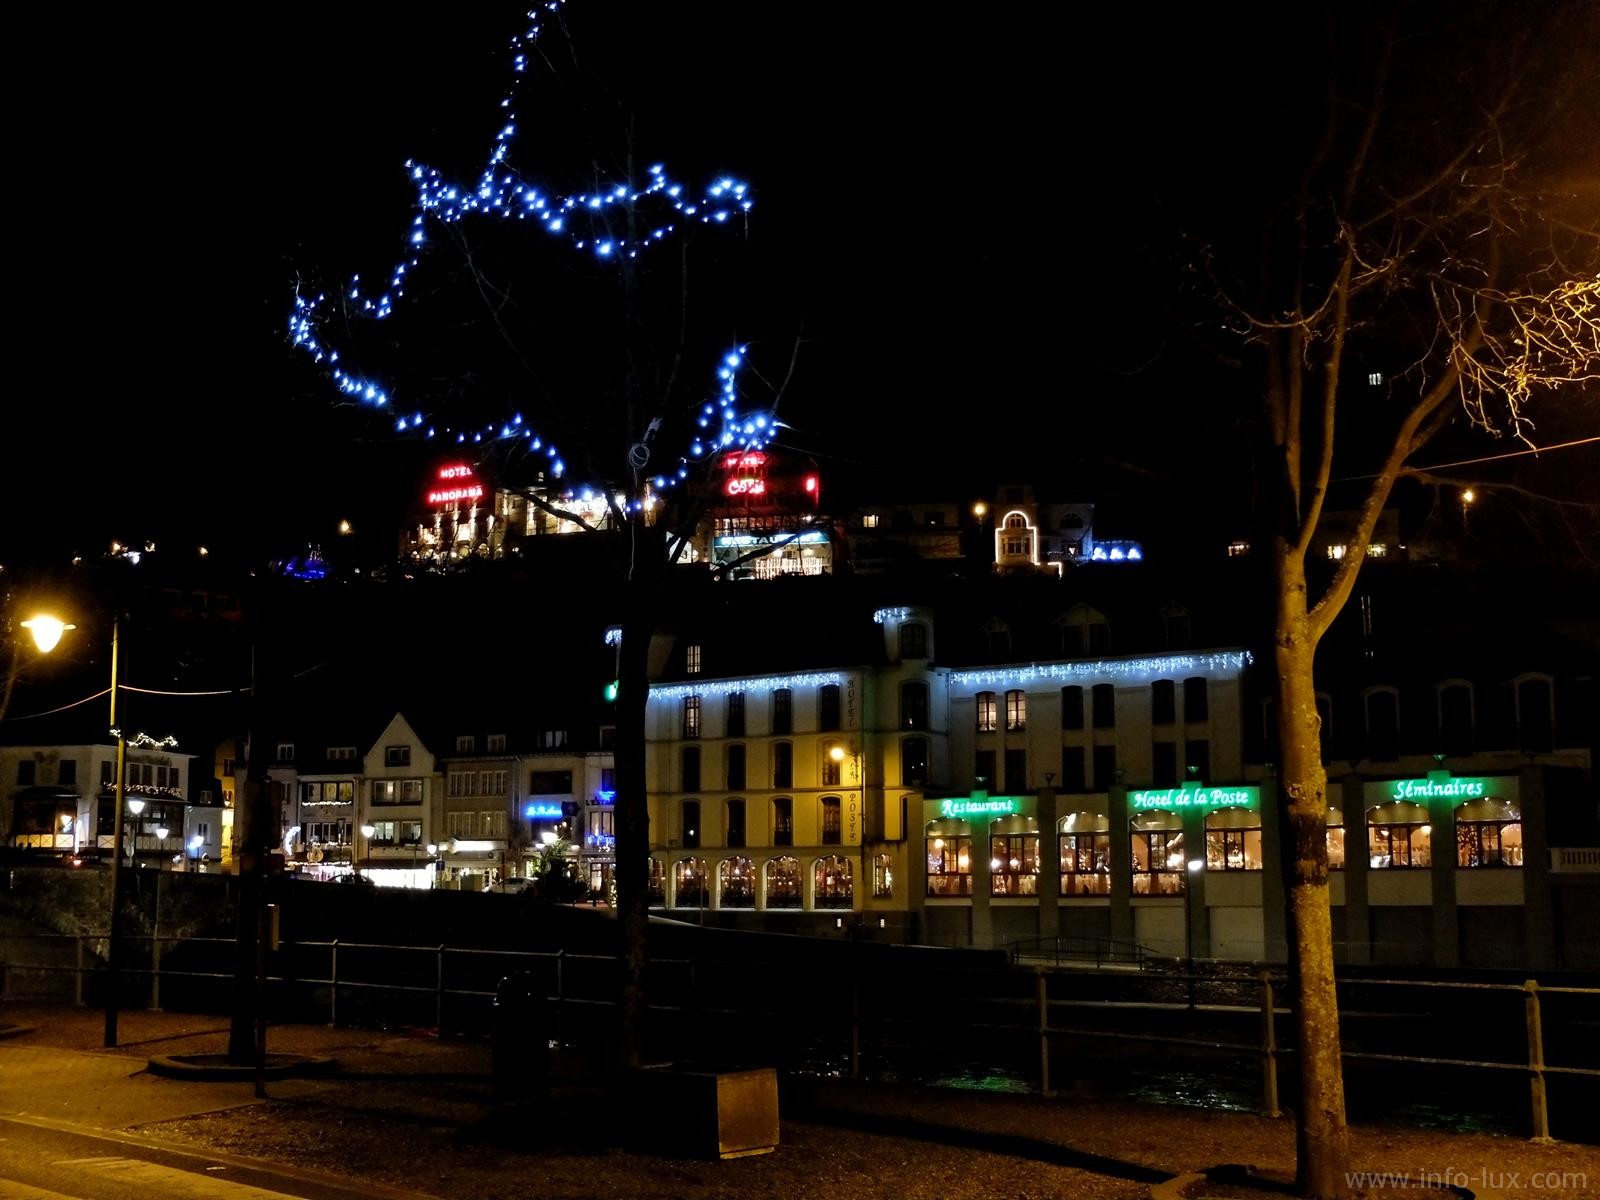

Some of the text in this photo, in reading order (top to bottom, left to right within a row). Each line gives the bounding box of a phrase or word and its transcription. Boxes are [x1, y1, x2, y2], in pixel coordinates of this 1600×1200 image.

[440, 466, 472, 478] HOTEL
[430, 487, 483, 503] PANORAMA
[1393, 778, 1483, 799] Séminaires
[1134, 788, 1248, 807] Hotel de la Poste
[942, 799, 1013, 816] Restaurant
